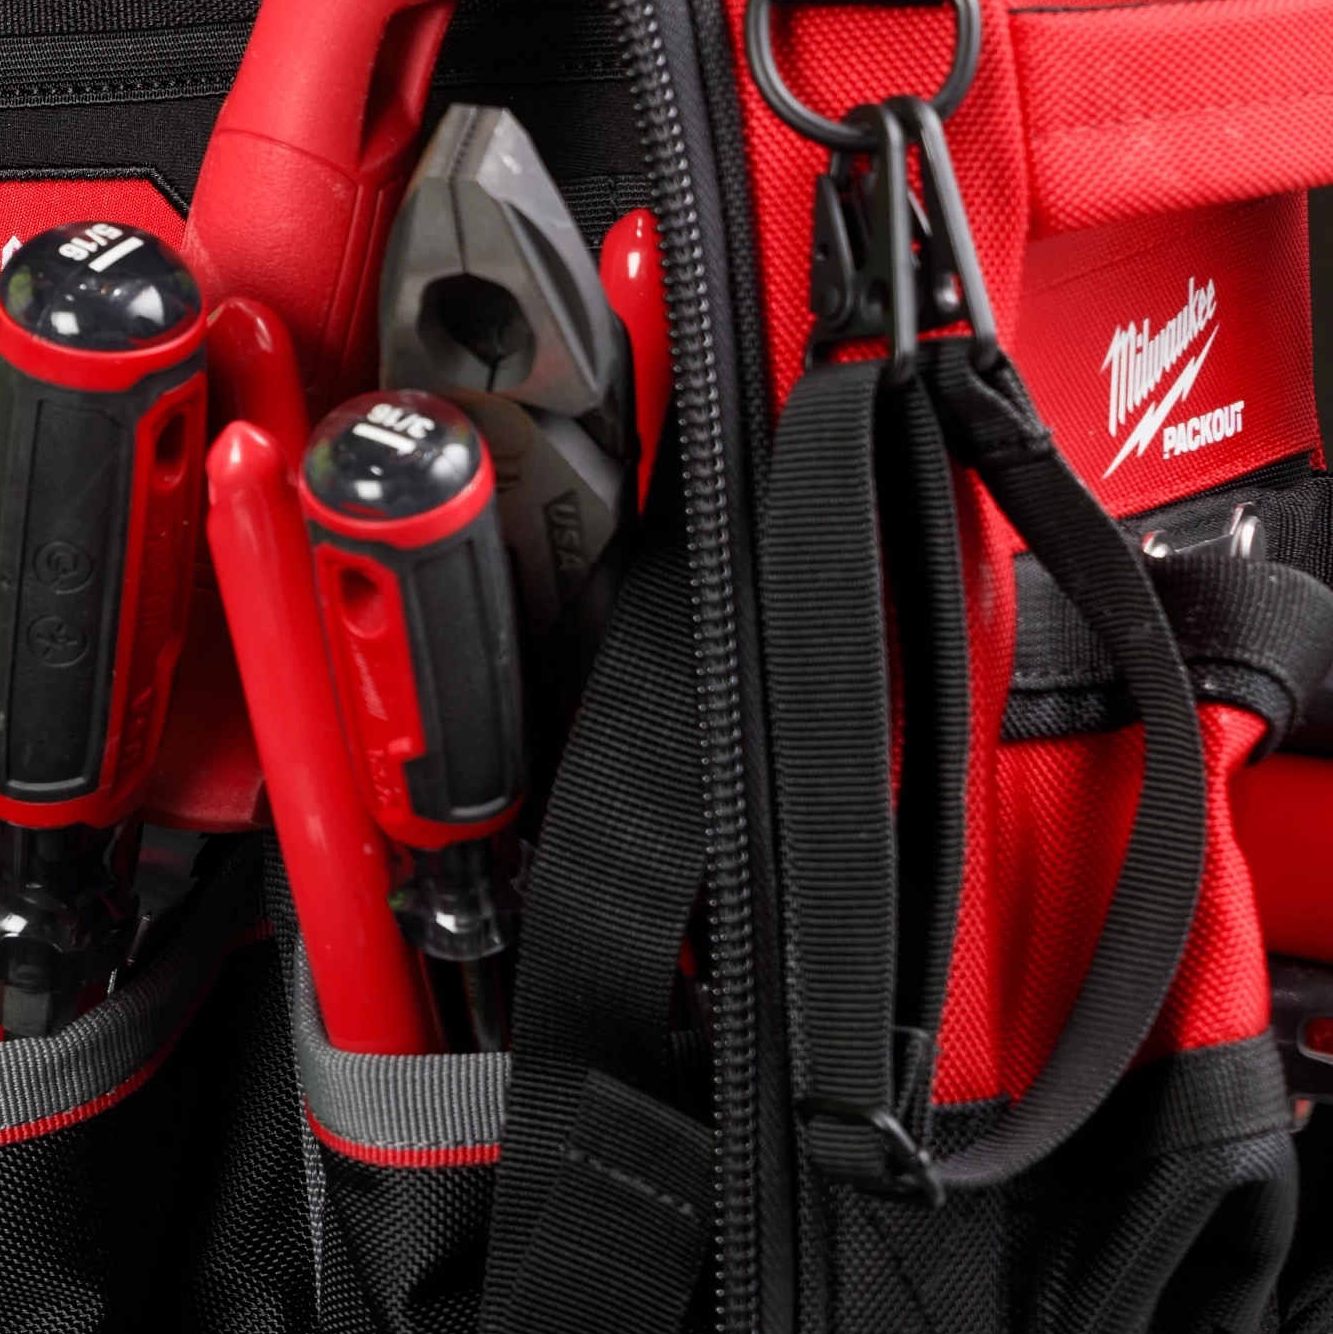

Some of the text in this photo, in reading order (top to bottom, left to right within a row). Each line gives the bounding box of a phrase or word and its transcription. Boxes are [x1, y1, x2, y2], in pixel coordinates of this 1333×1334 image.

[59, 223, 124, 263] 5/16
[1100, 276, 1217, 437] Milwaukee
[366, 402, 435, 440] 3/16
[1163, 400, 1245, 460] PACKOUT
